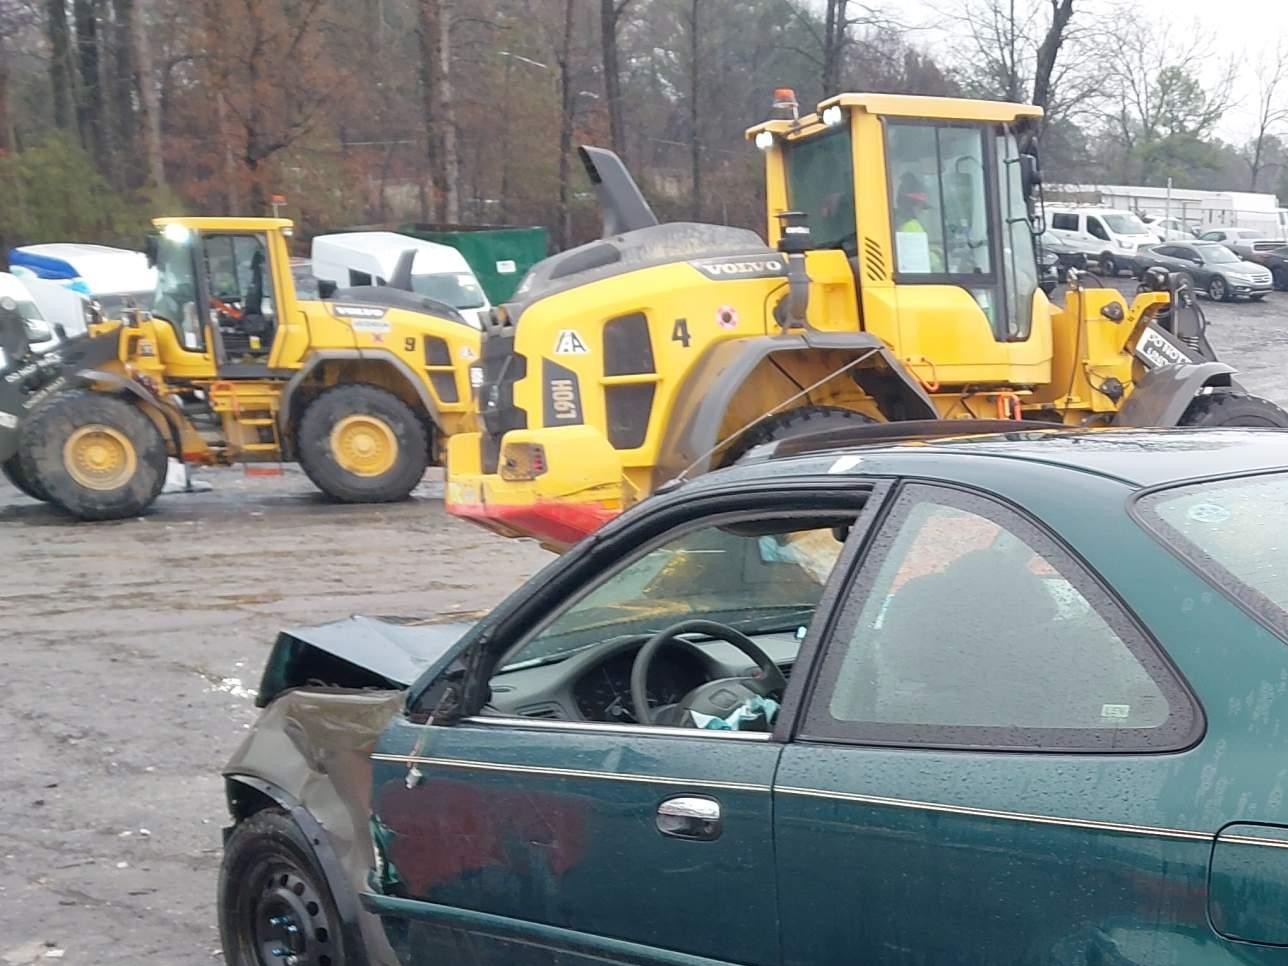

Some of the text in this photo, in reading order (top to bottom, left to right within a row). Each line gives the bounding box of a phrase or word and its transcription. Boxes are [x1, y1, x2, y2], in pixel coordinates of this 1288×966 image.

[701, 260, 782, 275] VOLVO
[672, 318, 691, 348] 4
[405, 337, 416, 352] 9
[550, 379, 577, 420] L90H
